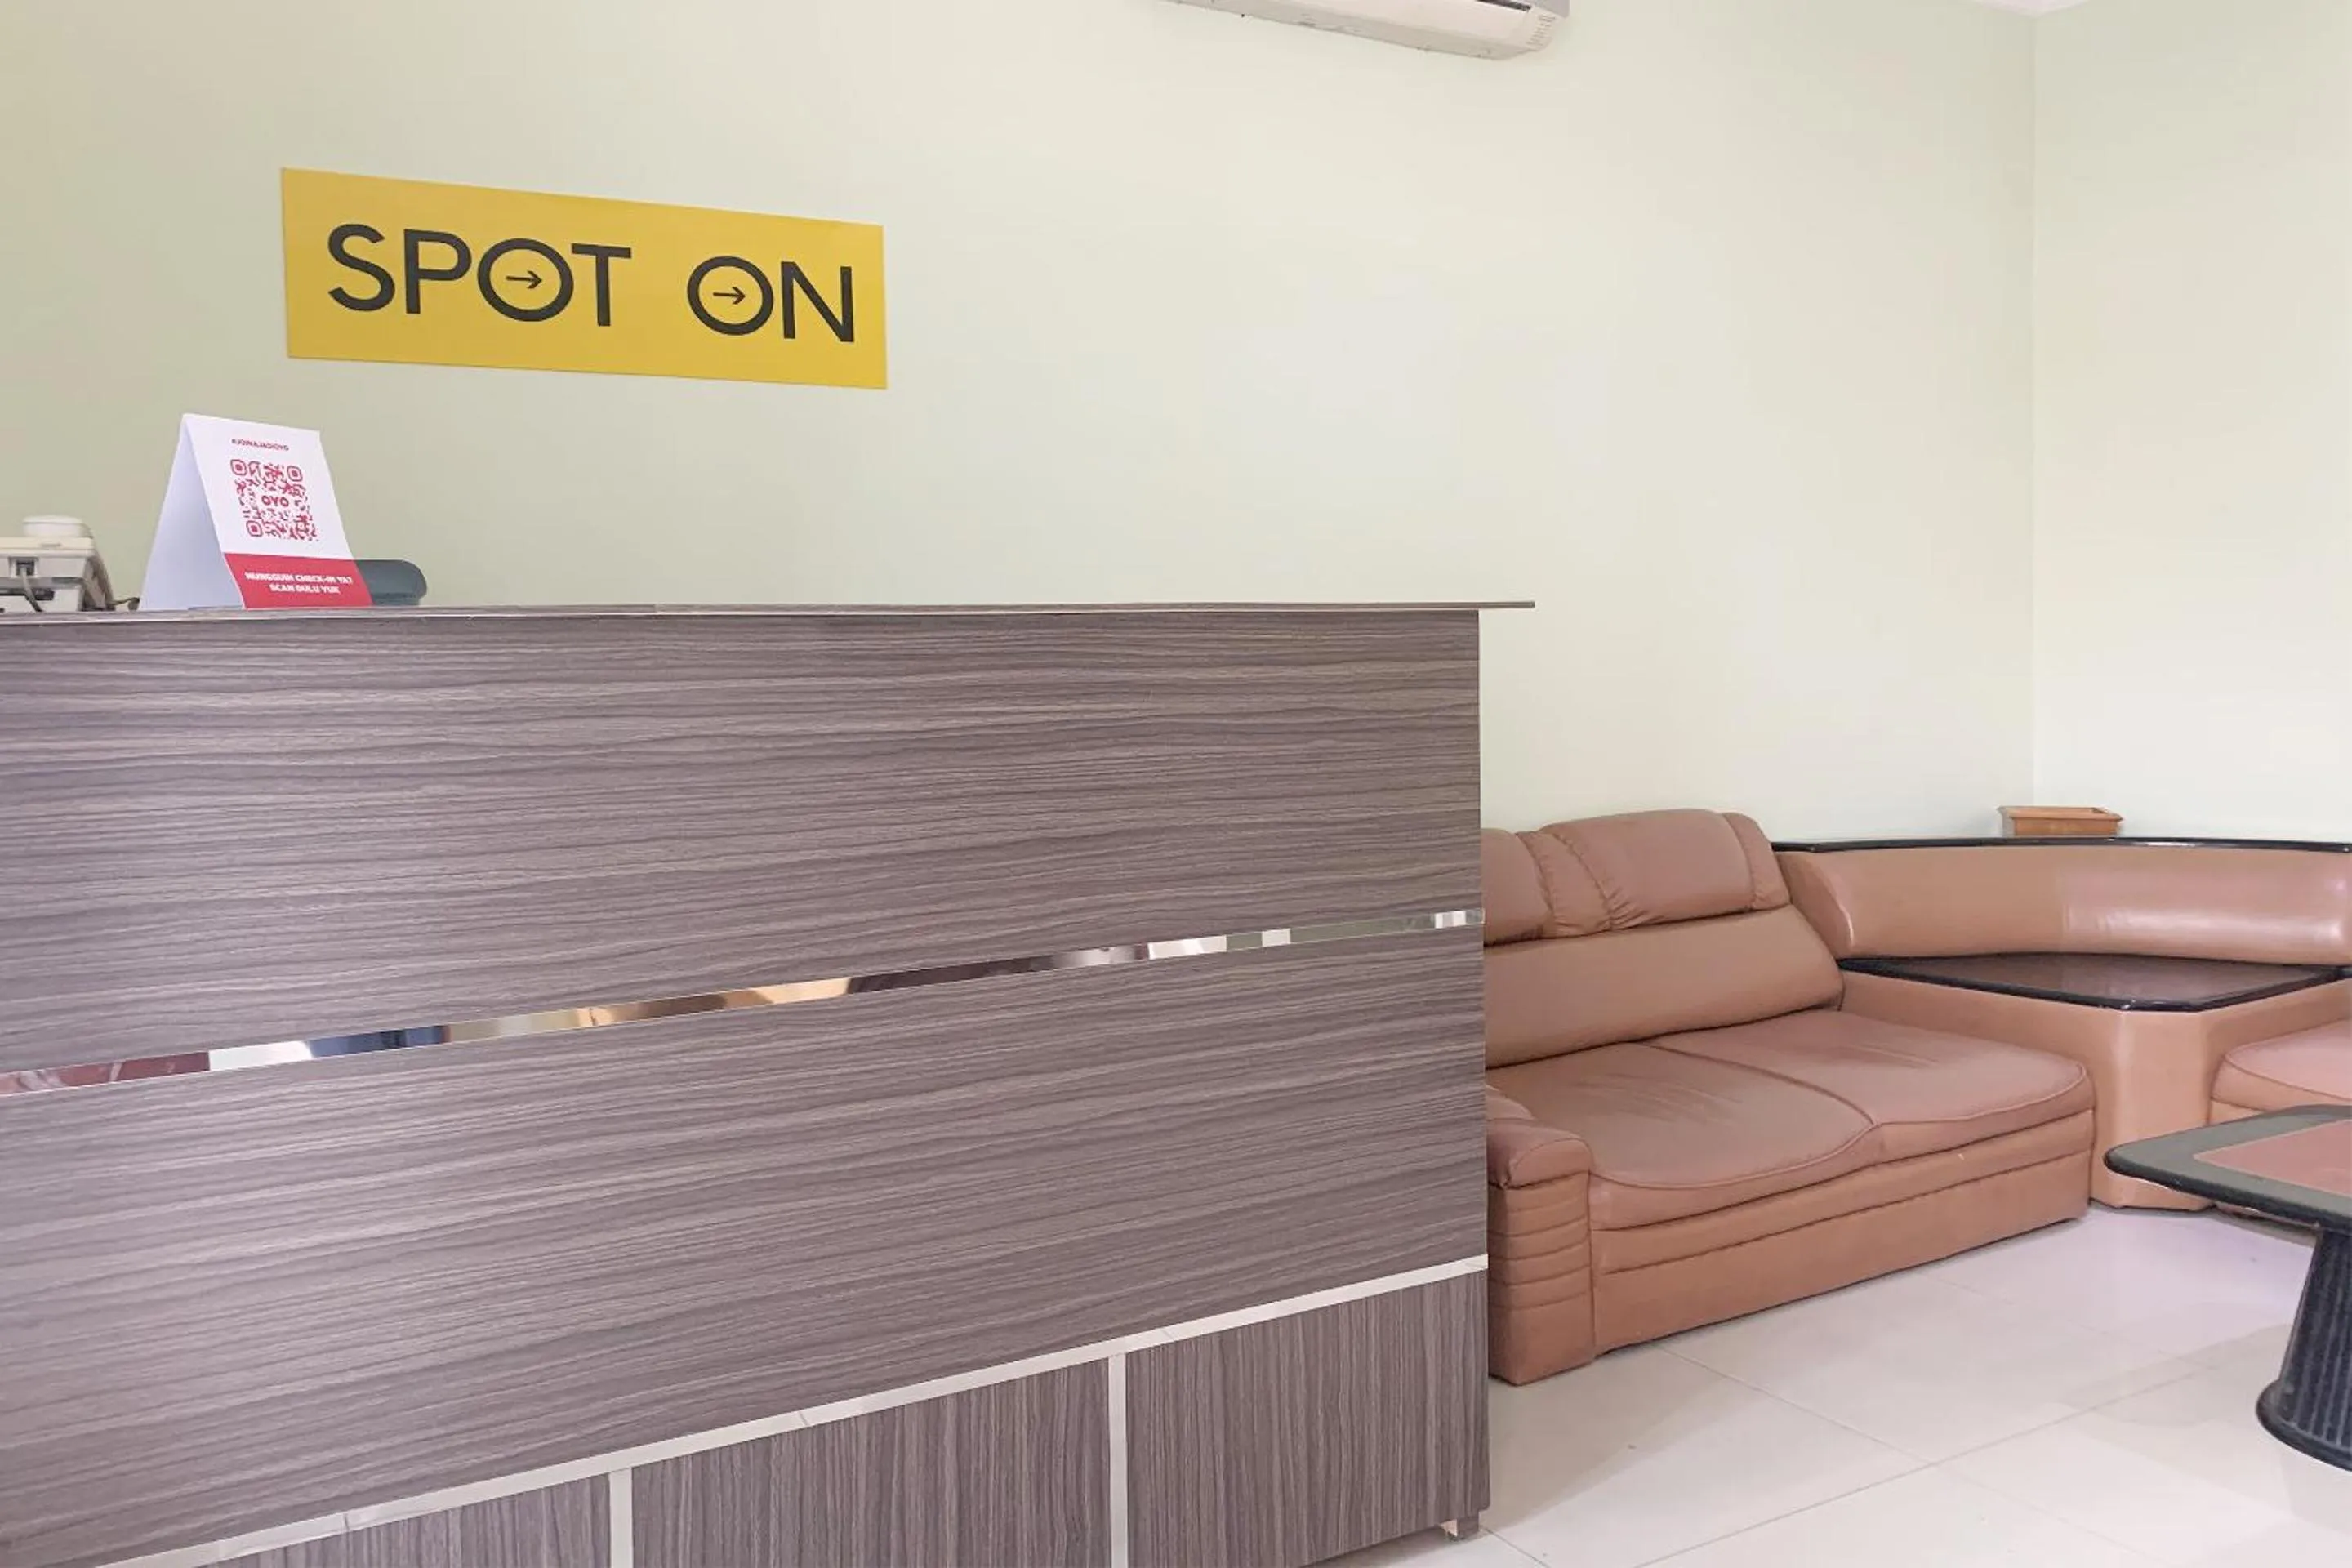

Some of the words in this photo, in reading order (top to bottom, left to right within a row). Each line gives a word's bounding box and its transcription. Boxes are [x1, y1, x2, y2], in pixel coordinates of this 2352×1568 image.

[327, 223, 632, 327] SPOT
[687, 255, 855, 343] ON
[261, 495, 289, 507] OYO
[269, 583, 296, 592] SCAN
